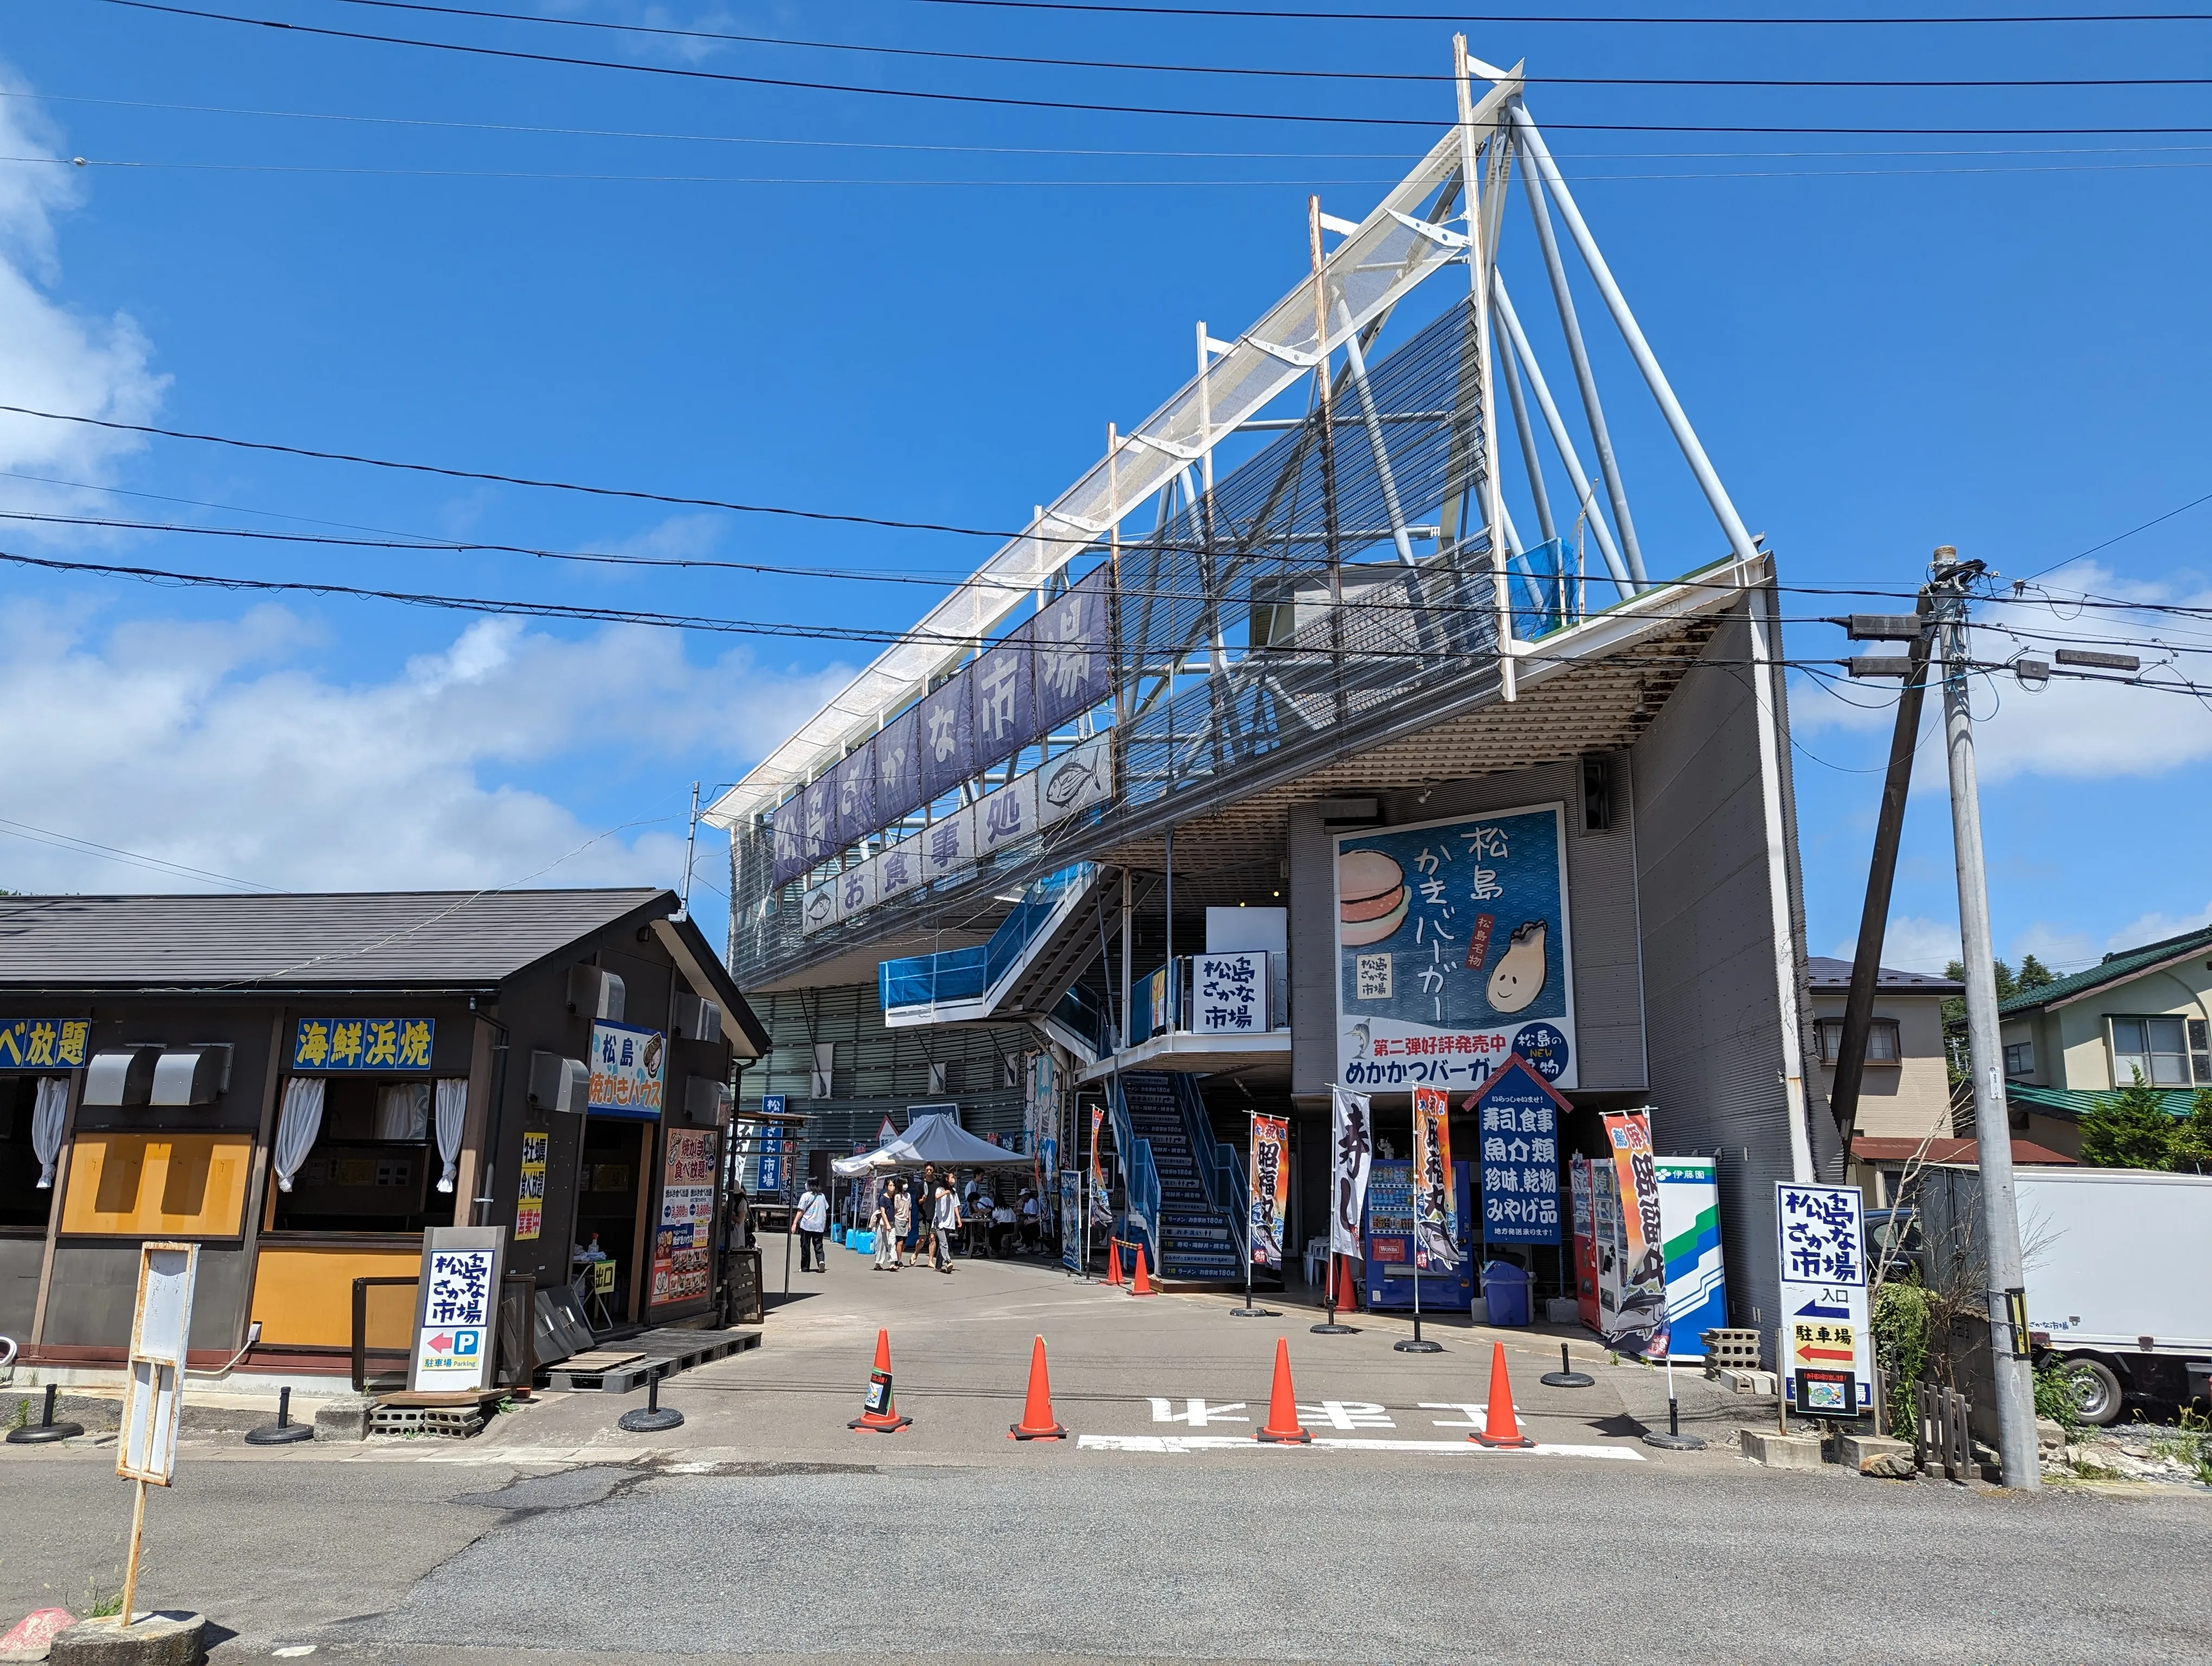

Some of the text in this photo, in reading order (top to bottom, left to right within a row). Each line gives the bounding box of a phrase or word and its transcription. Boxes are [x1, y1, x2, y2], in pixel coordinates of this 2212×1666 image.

[774, 595, 1091, 861] 松島さかな市場
[845, 790, 1022, 909] お食事処
[1461, 827, 1509, 900] 松島
[1414, 845, 1458, 1021] かきバーガー
[1468, 917, 1492, 967] 松島名物
[1203, 956, 1255, 984] 松島
[1361, 957, 1387, 972] 松島
[1361, 970, 1387, 982] さかな
[1203, 982, 1256, 1003] さかな
[1362, 983, 1386, 996] 市場
[1205, 1004, 1252, 1029] 市場
[0, 1022, 88, 1066] べ放題
[297, 1021, 432, 1067] 海鮮浜焼
[603, 1034, 634, 1067] 松島
[1373, 1034, 1506, 1057] 第二弾好評発売中
[1517, 1030, 1562, 1048] 松島の
[1530, 1049, 1553, 1058] NEW
[589, 1072, 661, 1108] 焼がきハウス
[1491, 1095, 1543, 1104] いらっしゃいませ！
[681, 1137, 704, 1158] 焼がき
[762, 1099, 781, 1187] 松さかな市場
[1484, 1137, 1555, 1163] 魚介類
[674, 1159, 708, 1181] 食べ放題！
[1339, 1103, 1370, 1233] 寿し
[1672, 1169, 1705, 1180] 伊藤園
[520, 1171, 544, 1200] 食べ放題
[518, 1208, 540, 1235] 営業中
[1487, 1198, 1558, 1224] みやげ品
[1785, 1191, 1854, 1228] 松島
[1494, 1227, 1552, 1236] 地方発送承ります！
[1787, 1222, 1856, 1251] さかな
[435, 1253, 487, 1281] 松島
[1790, 1247, 1856, 1282] 市場
[434, 1279, 485, 1300] さかな
[595, 1266, 613, 1289] 出口
[1822, 1288, 1848, 1303] 入口
[432, 1299, 482, 1324] 市場
[458, 1334, 474, 1352] P
[1796, 1325, 1852, 1345] 駐車場
[425, 1359, 476, 1368] 駐車場 Parking
